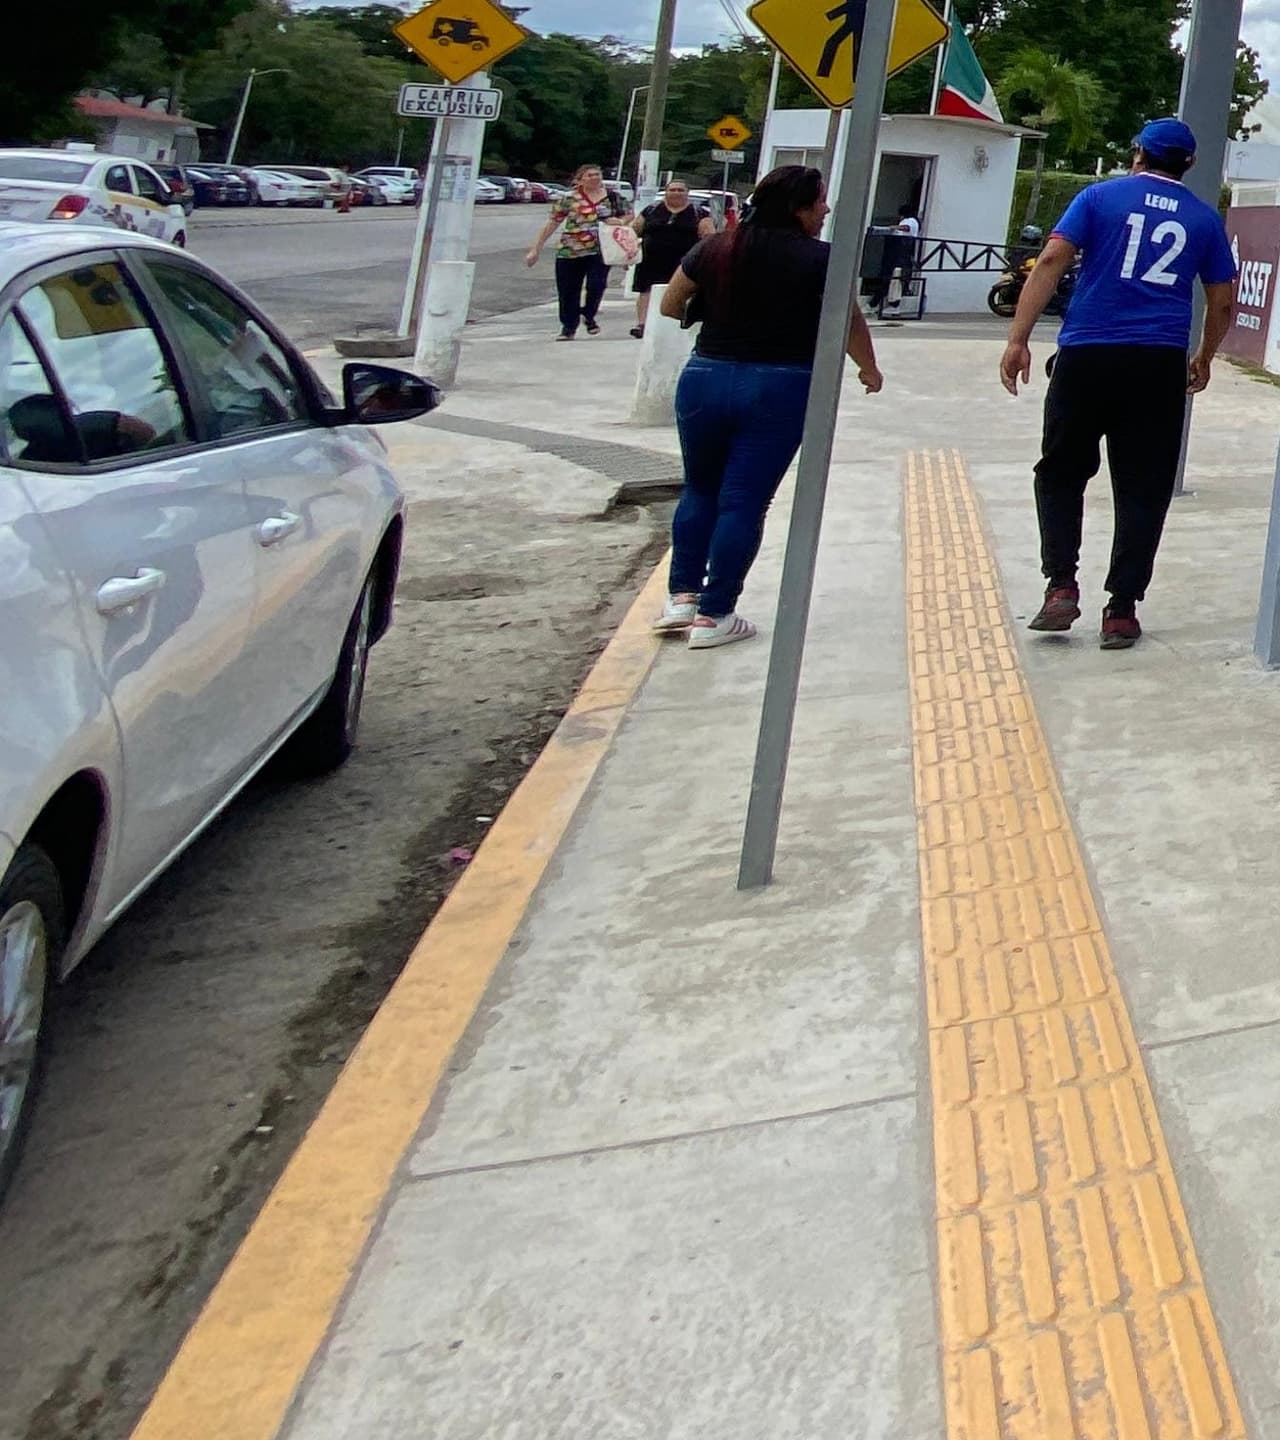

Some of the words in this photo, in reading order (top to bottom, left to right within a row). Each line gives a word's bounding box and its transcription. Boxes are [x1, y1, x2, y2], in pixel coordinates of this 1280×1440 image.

[418, 89, 484, 103] CARRIL
[405, 100, 493, 115] EXCLUSIVO
[1144, 192, 1179, 213] LEON
[1120, 212, 1187, 286] 12
[1237, 260, 1273, 309] ISSET
